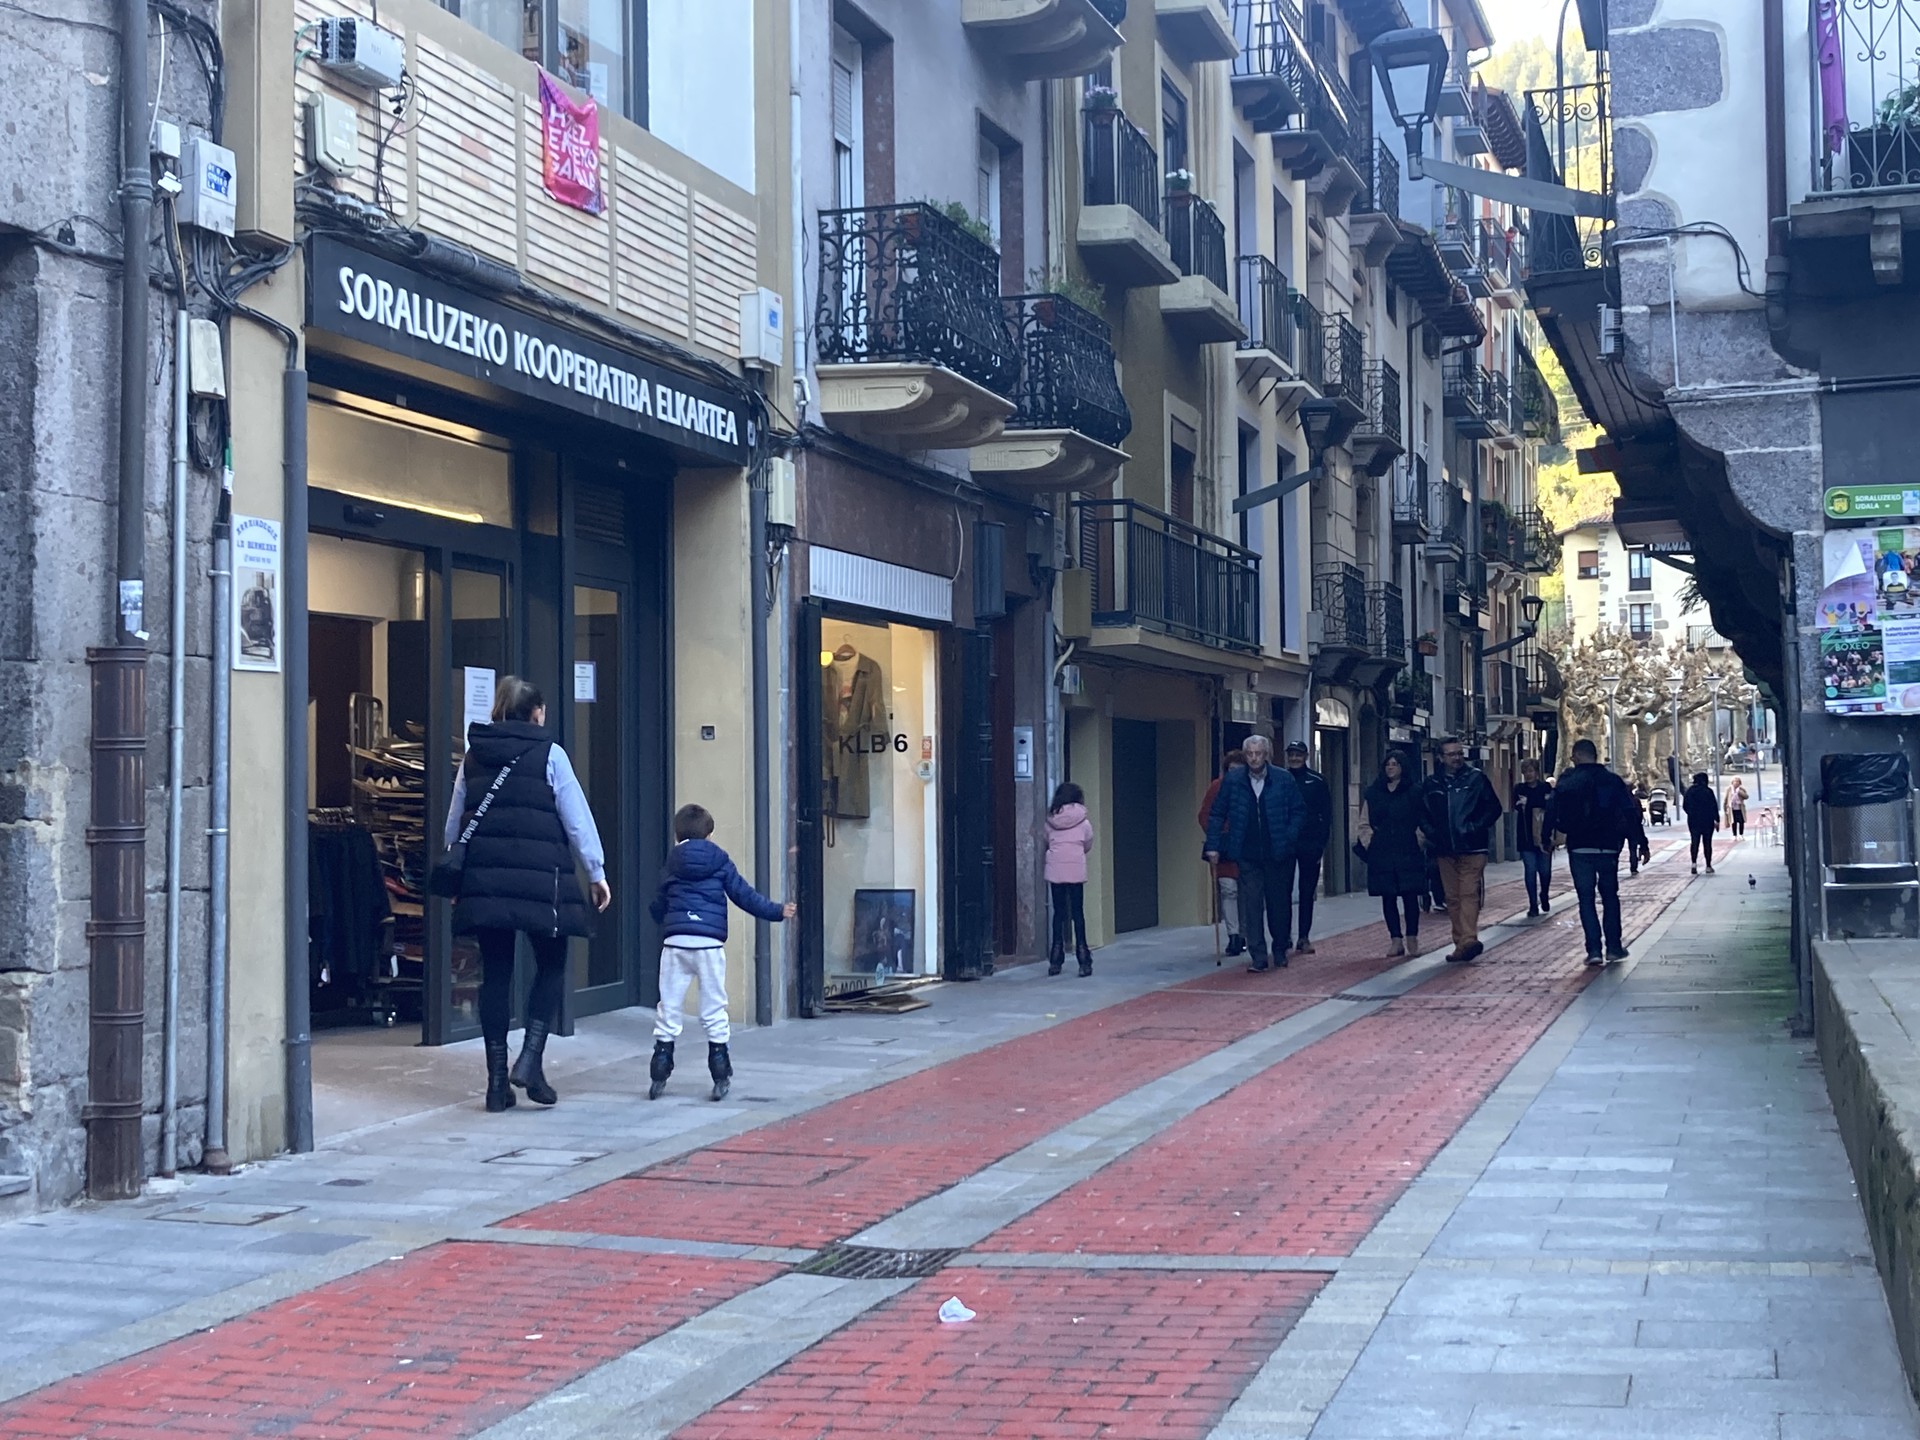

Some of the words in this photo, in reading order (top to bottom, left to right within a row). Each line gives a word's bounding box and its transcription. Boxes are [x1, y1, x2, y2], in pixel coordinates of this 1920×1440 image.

[339, 266, 508, 366] SORALUZEKO
[514, 330, 653, 417] KOOPERATIBA
[656, 384, 739, 446] ELKARTEA
[1854, 493, 1902, 502] SORALUZEKO
[1854, 502, 1880, 510] UDALA
[1835, 641, 1870, 652] BOXEO
[838, 732, 888, 754] KLB
[893, 733, 908, 753] 6
[490, 765, 511, 790] BIMBA
[474, 792, 494, 817] BIMBA
[459, 819, 479, 844] BIMBA
